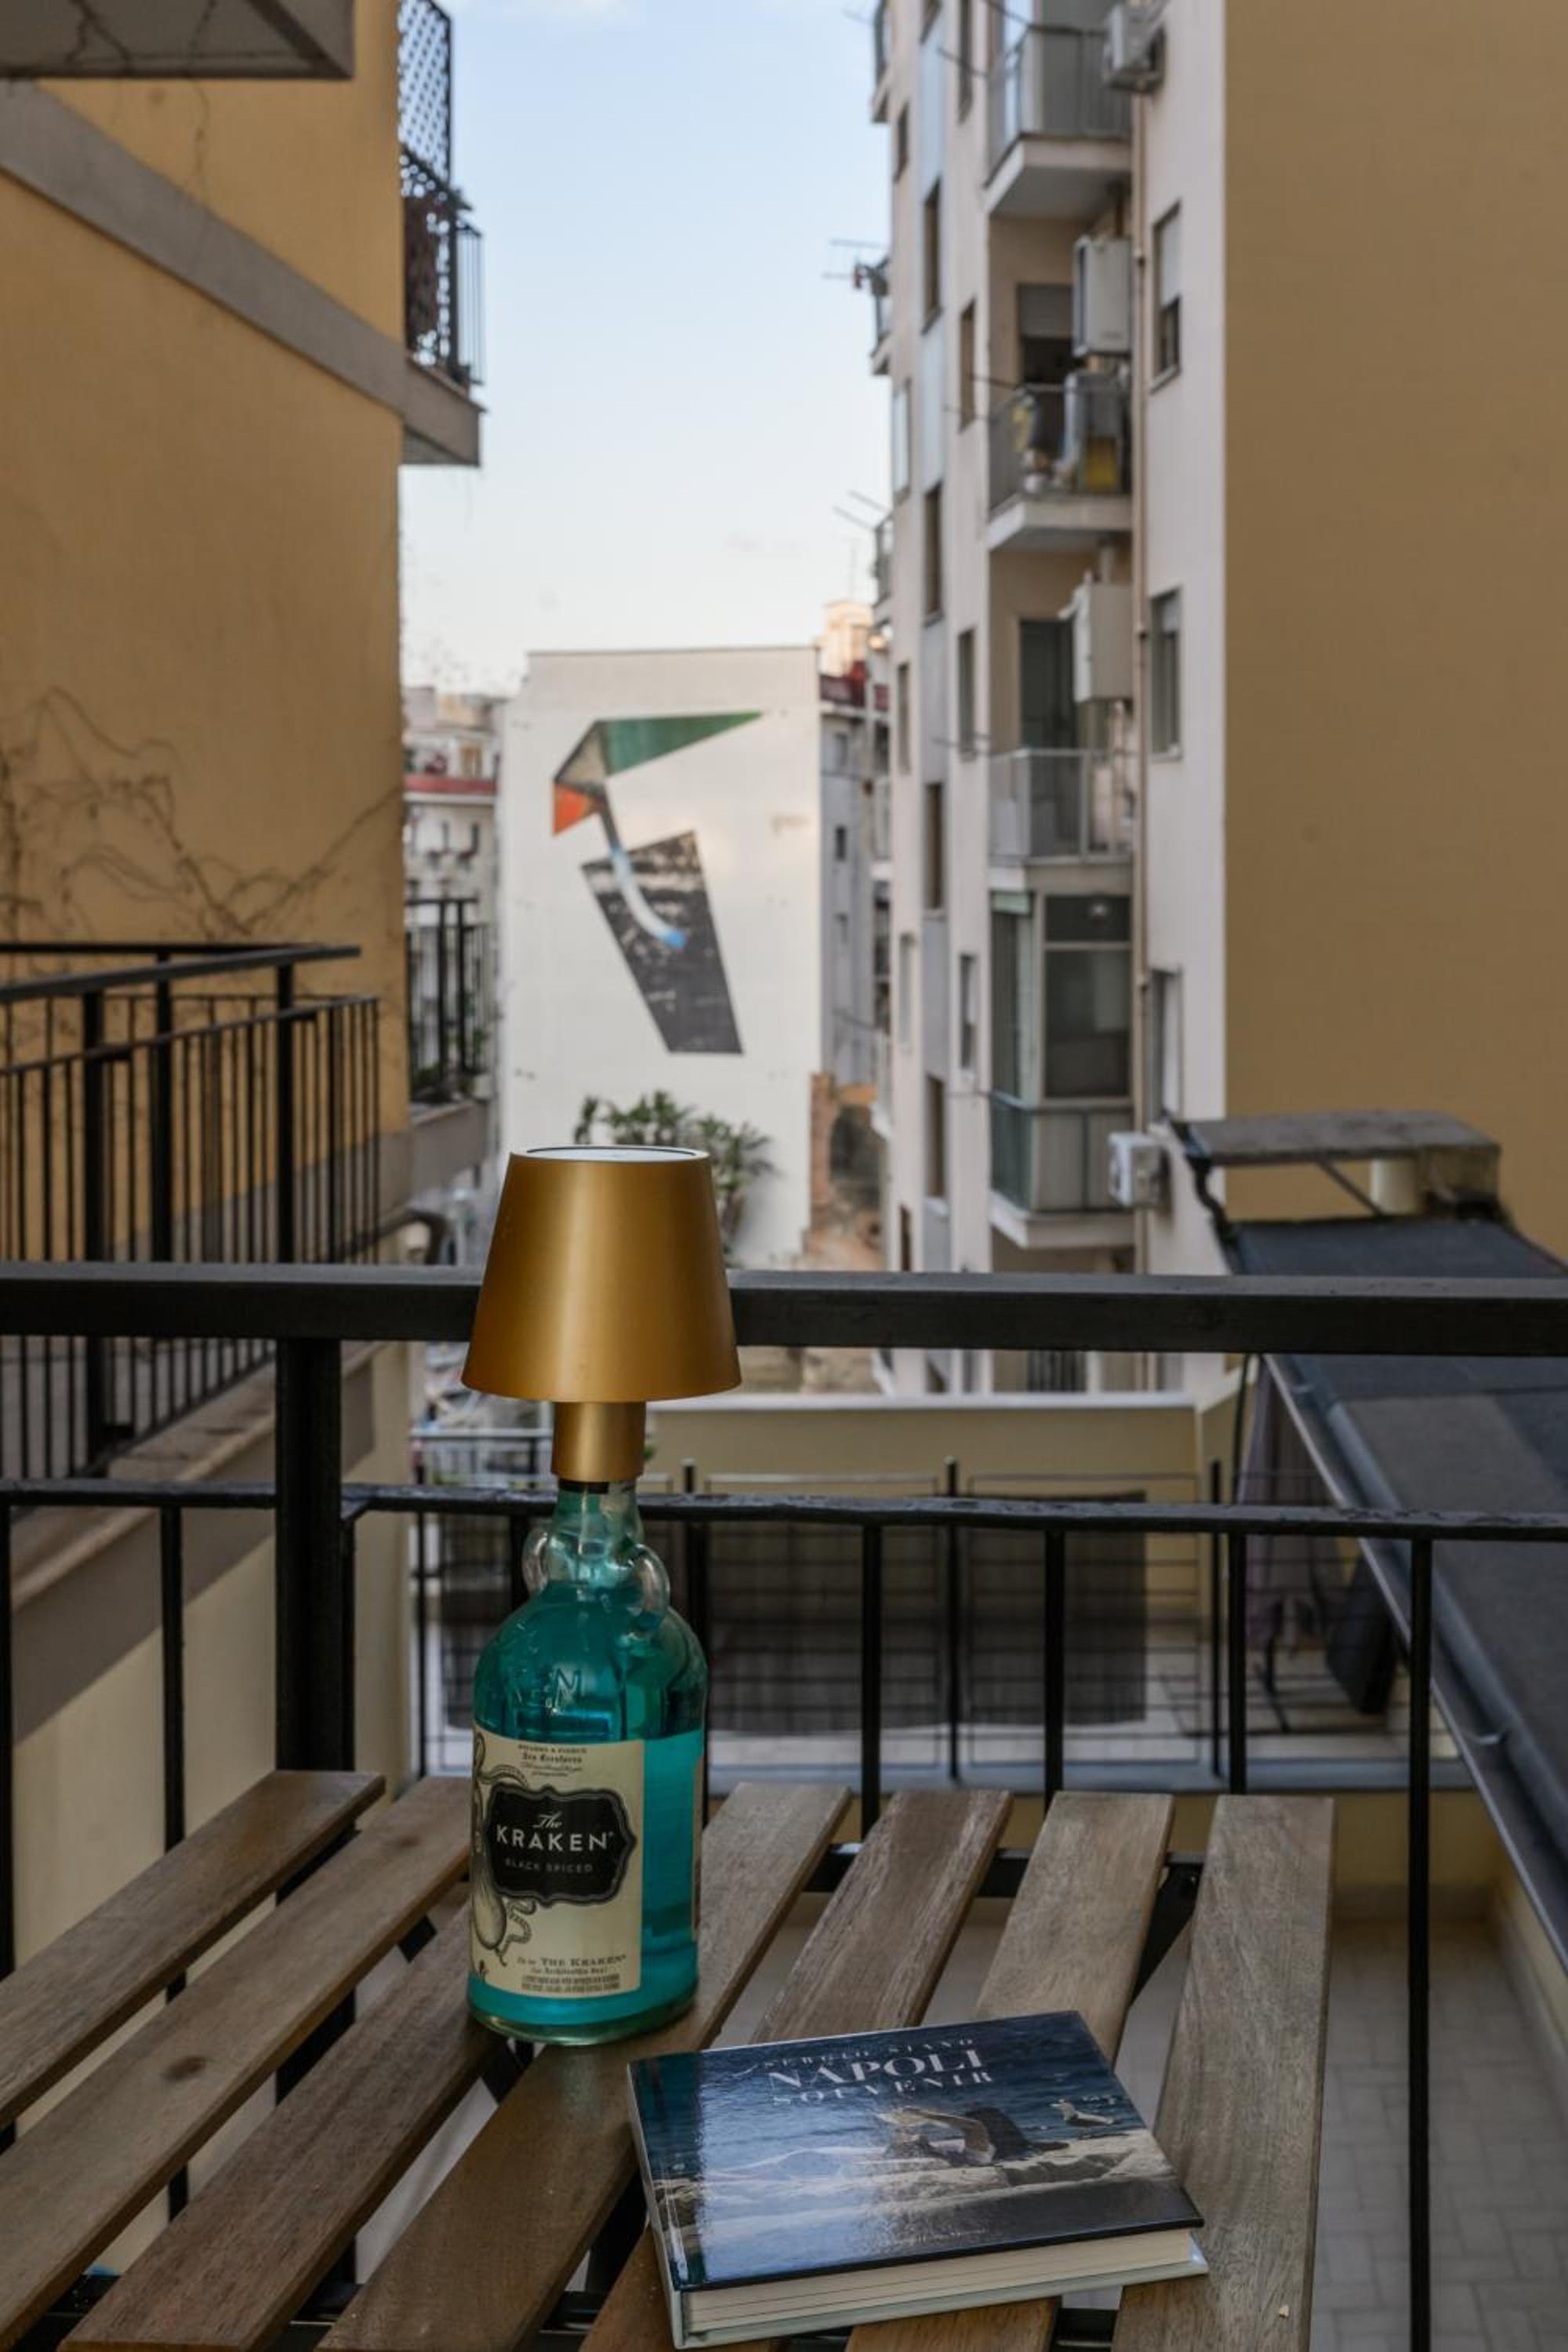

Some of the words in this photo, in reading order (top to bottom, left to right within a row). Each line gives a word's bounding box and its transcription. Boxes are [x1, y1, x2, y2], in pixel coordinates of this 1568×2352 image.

[532, 1810, 563, 1829] The
[495, 1824, 608, 1853] KRAKEN
[504, 1857, 540, 1871] BLACK
[545, 1862, 594, 1874] SPICED
[768, 2049, 984, 2094] NAPOLI
